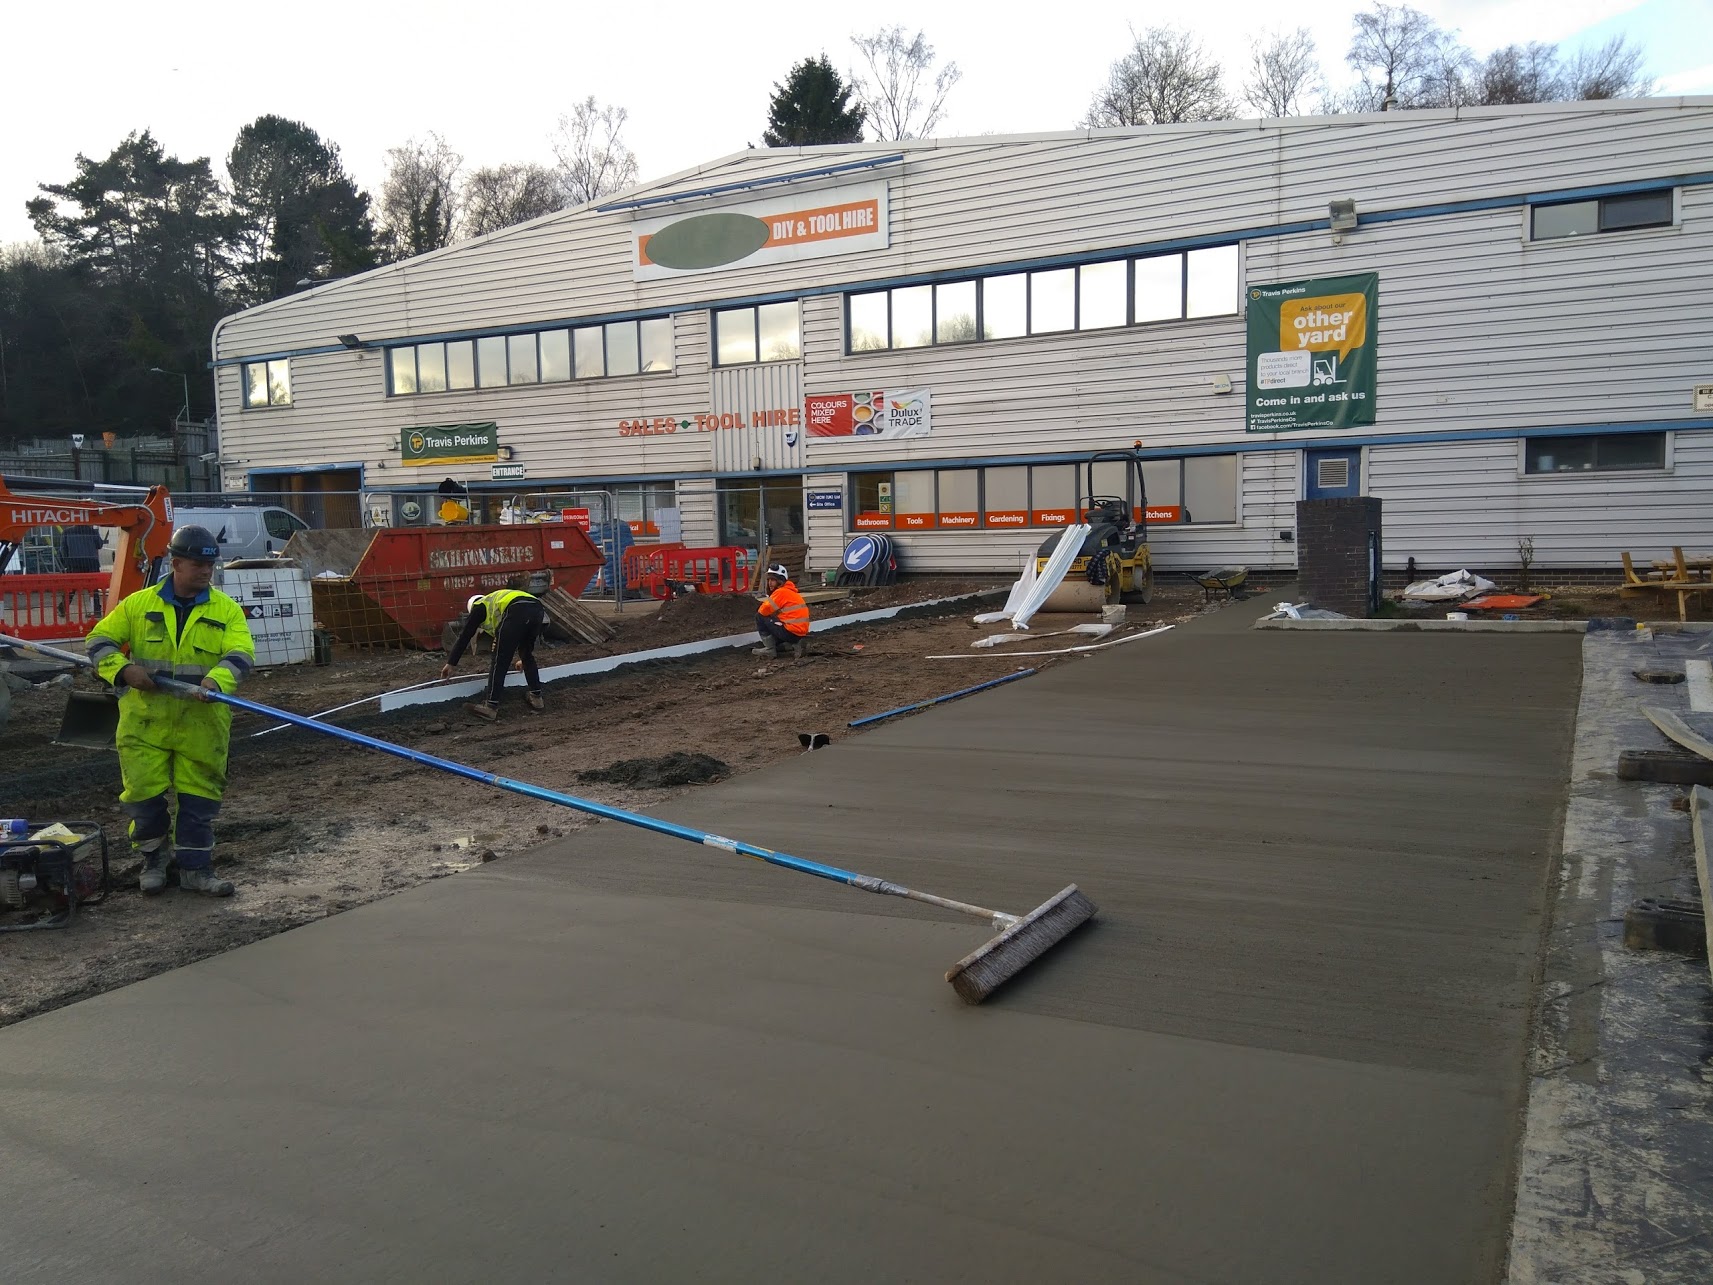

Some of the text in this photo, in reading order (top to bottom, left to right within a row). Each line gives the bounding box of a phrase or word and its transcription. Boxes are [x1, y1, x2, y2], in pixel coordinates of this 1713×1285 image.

[773, 207, 873, 240] DIY & TOOL HIRE
[1282, 287, 1306, 295] Perkins
[1293, 310, 1353, 329] other
[1298, 325, 1346, 348] yard
[1256, 391, 1366, 407] Come in and ask us
[810, 400, 848, 410] COLOURS
[811, 408, 836, 417] MIXED
[891, 408, 919, 418] Dulux
[618, 408, 800, 437] SALES TOOL HIRE
[811, 416, 832, 424] HERE
[888, 416, 922, 427] TRADE
[1256, 421, 1334, 430] facebook.com/TravisPerkinsCo
[426, 434, 489, 448] Travis Perkins
[493, 466, 523, 476] ENTRANCE
[11, 509, 90, 523] HITACHI
[989, 514, 1024, 524] Gardening
[1041, 513, 1065, 522] Fixings
[1145, 510, 1172, 519] itchens
[906, 517, 923, 525] Tools
[941, 516, 975, 525] Machinery
[430, 546, 534, 569] SKILTON SKIPS
[443, 576, 475, 590] 01892
